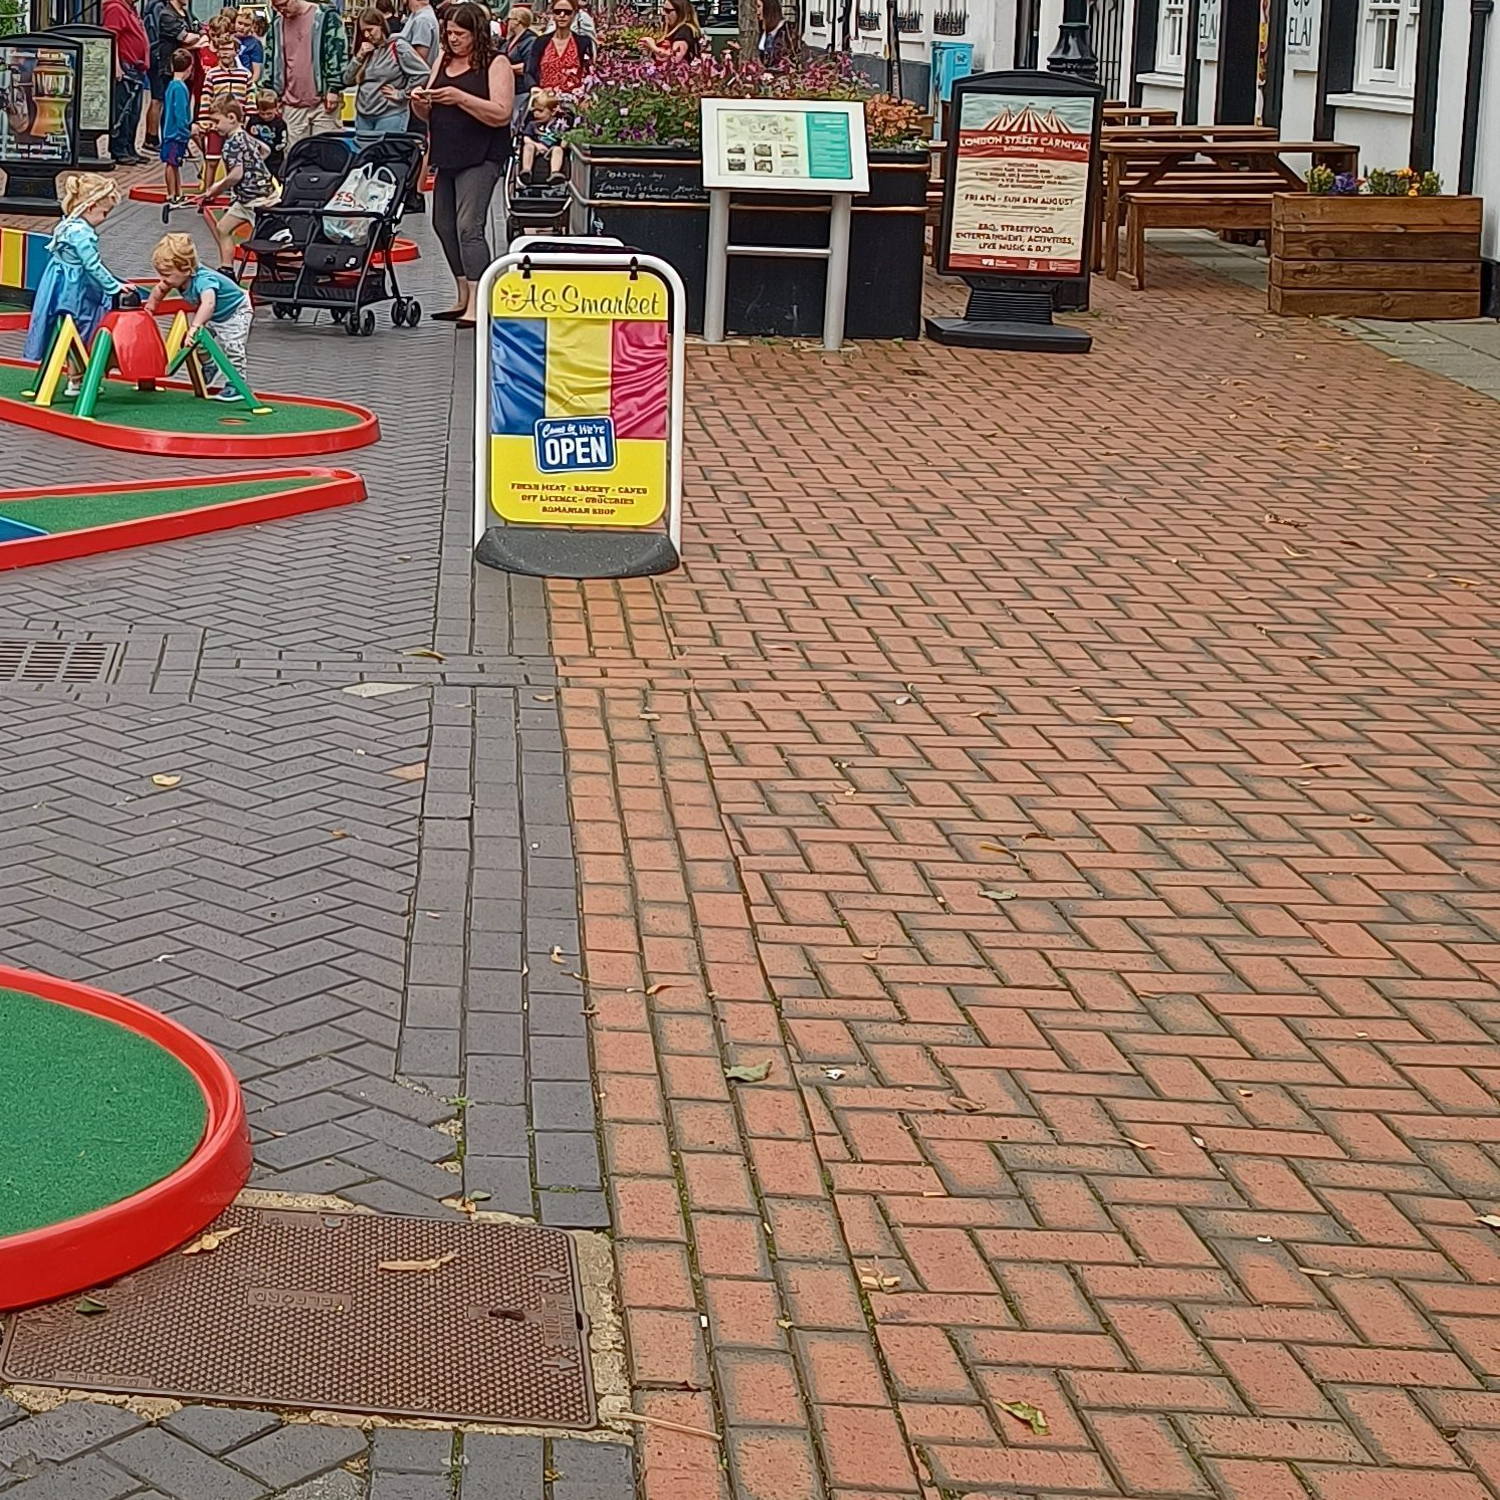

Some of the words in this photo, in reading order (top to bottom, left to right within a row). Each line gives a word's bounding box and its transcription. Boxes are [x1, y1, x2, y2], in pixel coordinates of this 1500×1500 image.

[959, 136, 1002, 147] LONDON
[1004, 135, 1039, 145] STREET
[1040, 137, 1089, 151] CARNIVAL
[1003, 195, 1020, 203] SUN
[1027, 235, 1075, 245] ACTIVITIES,
[978, 242, 997, 250] LIVE
[998, 244, 1025, 252] MUSIC
[579, 424, 605, 435] We're
[545, 436, 607, 465] OPEN
[511, 482, 539, 491] FRESH
[541, 483, 566, 492] MEAT
[574, 485, 610, 494] BAKERY
[585, 495, 635, 505] GROCERIES
[542, 506, 590, 515] ROMANIAN
[592, 508, 616, 516] SHOP
